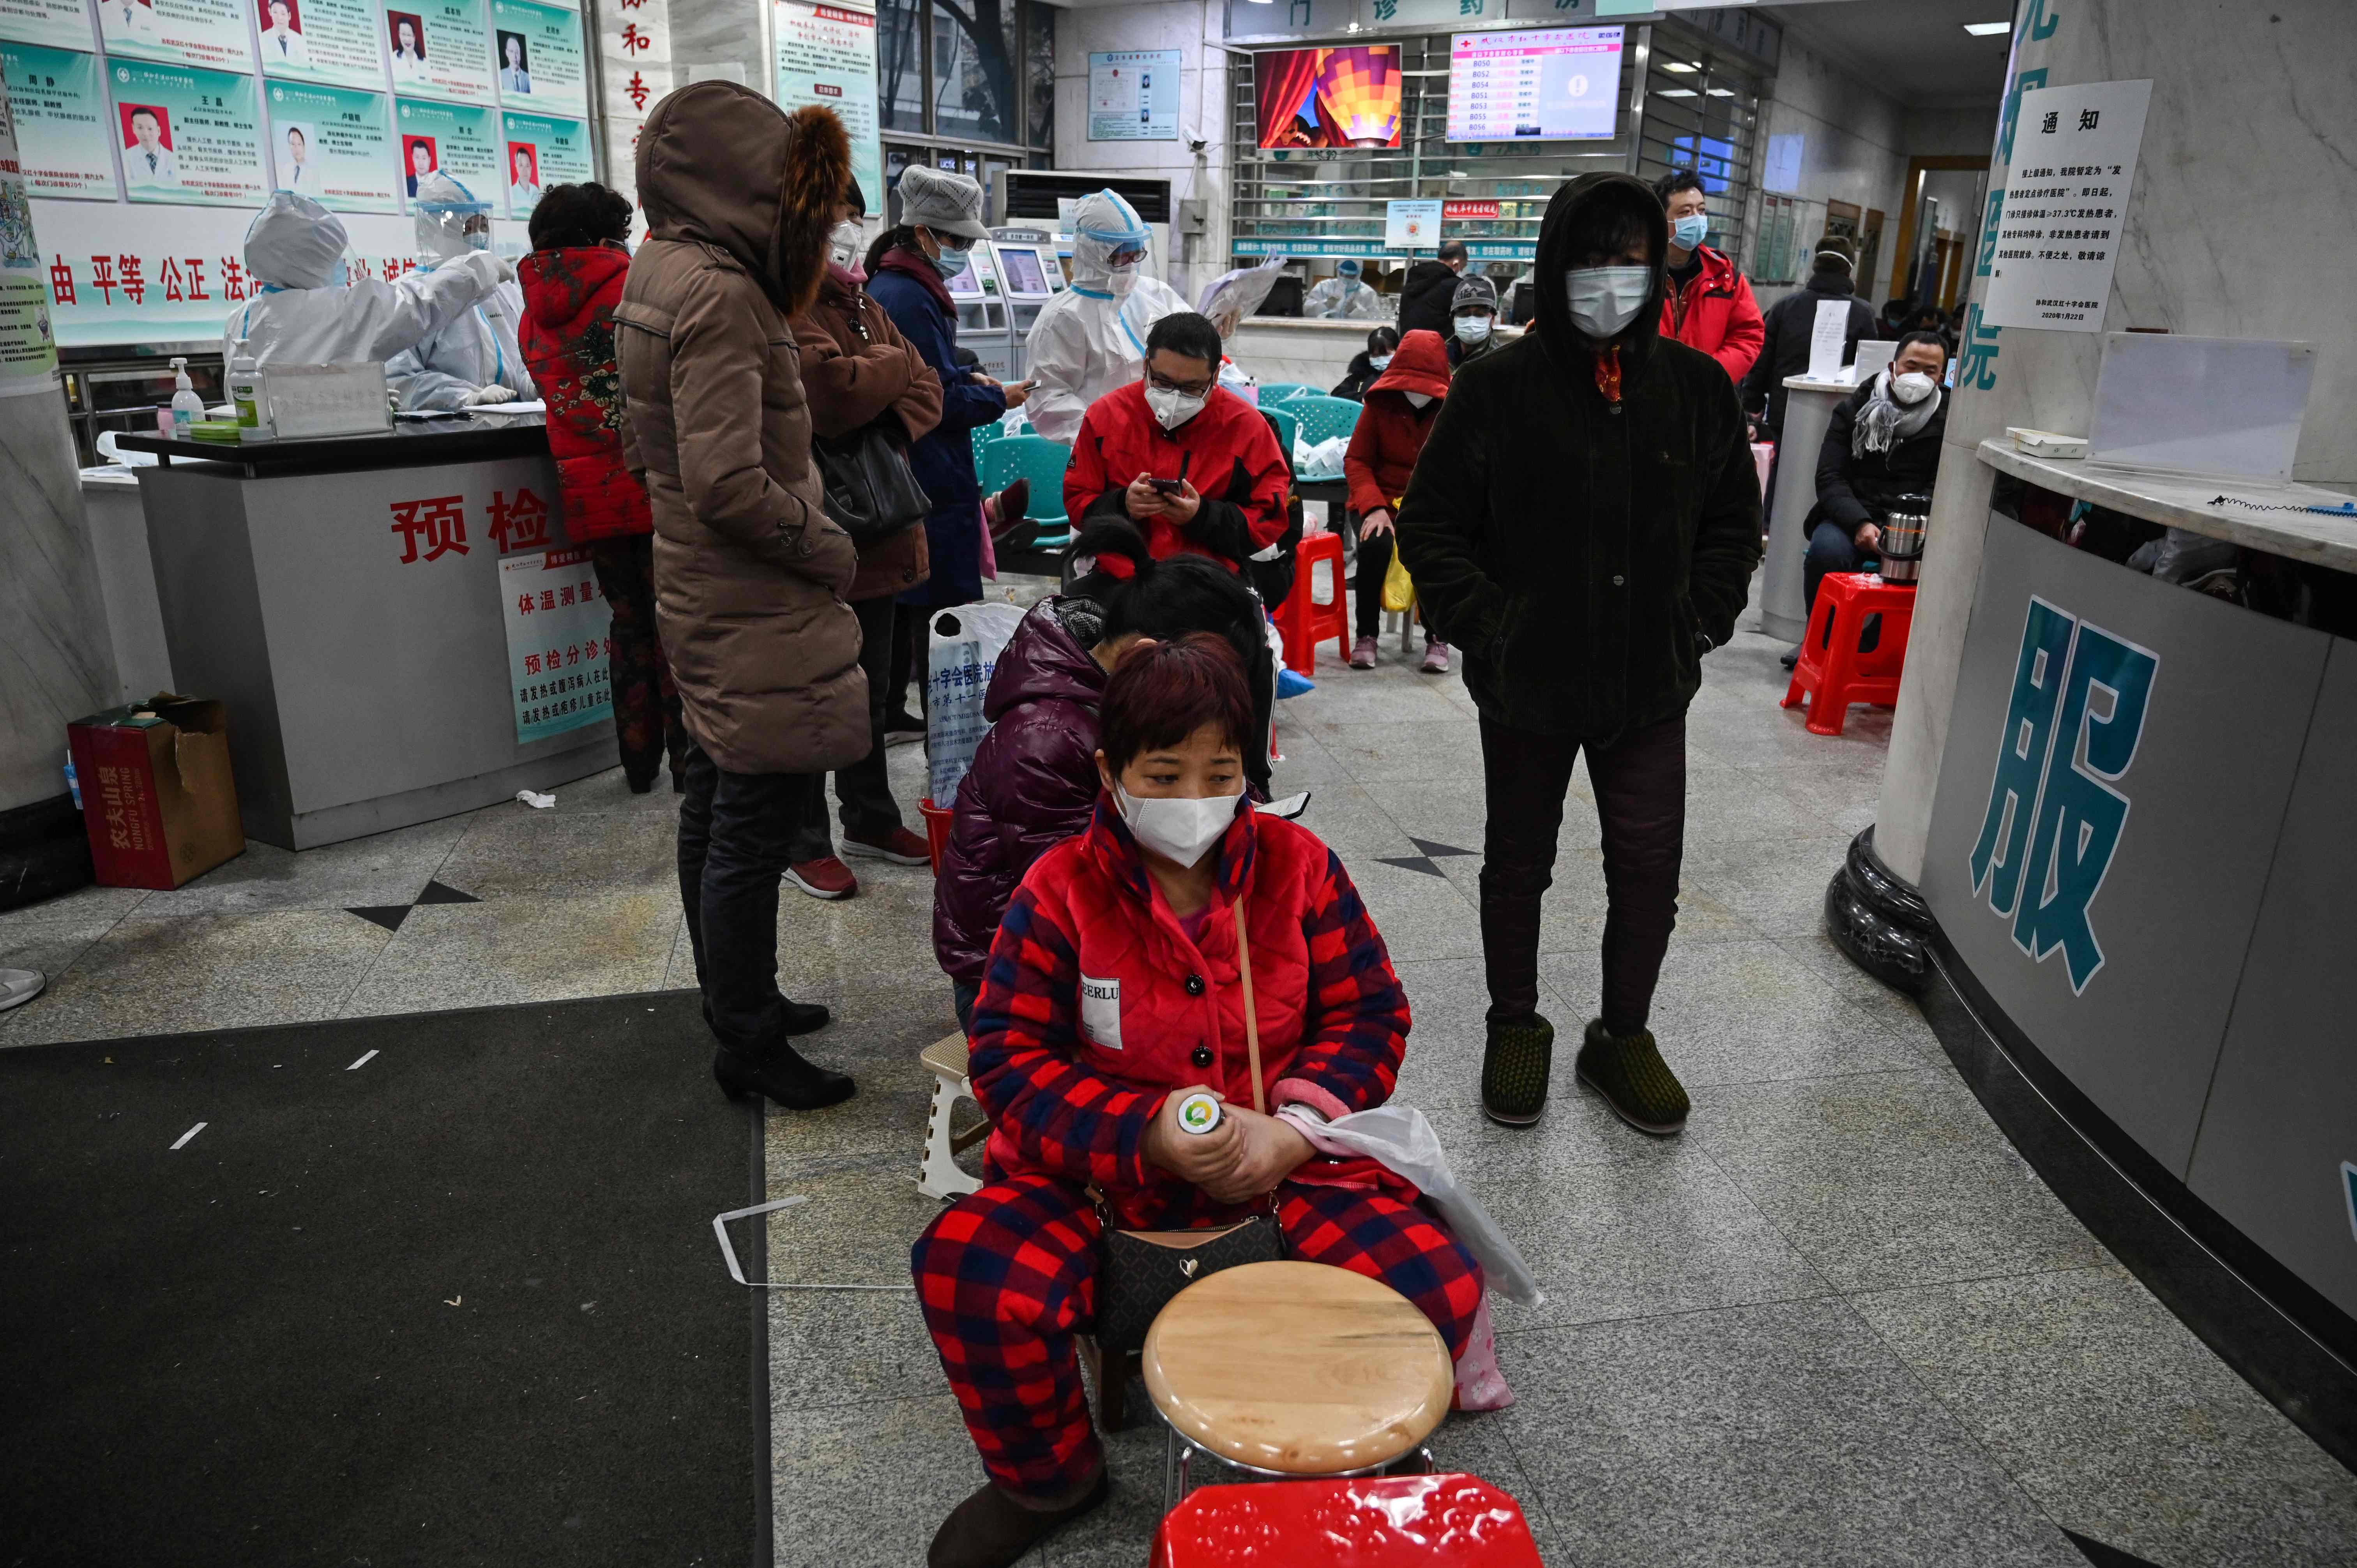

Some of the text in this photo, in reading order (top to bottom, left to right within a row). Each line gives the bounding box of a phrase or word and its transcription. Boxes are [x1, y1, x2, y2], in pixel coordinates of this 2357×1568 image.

[2041, 108, 2099, 134] 通知
[91, 254, 145, 305] 平等
[160, 256, 210, 303] 公正
[2035, 299, 2098, 309] 协和武汉红十字会医院
[2042, 312, 2084, 321] 2020年1月22日
[390, 488, 552, 565] 预检
[520, 667, 609, 704] 请发热或腹泻病人在此
[522, 687, 611, 726] 请发热或疱疹儿童在此
[98, 766, 131, 850] 农夫山泉
[119, 767, 144, 850] NONGFU SPRING
[1969, 593, 2160, 998] 服
